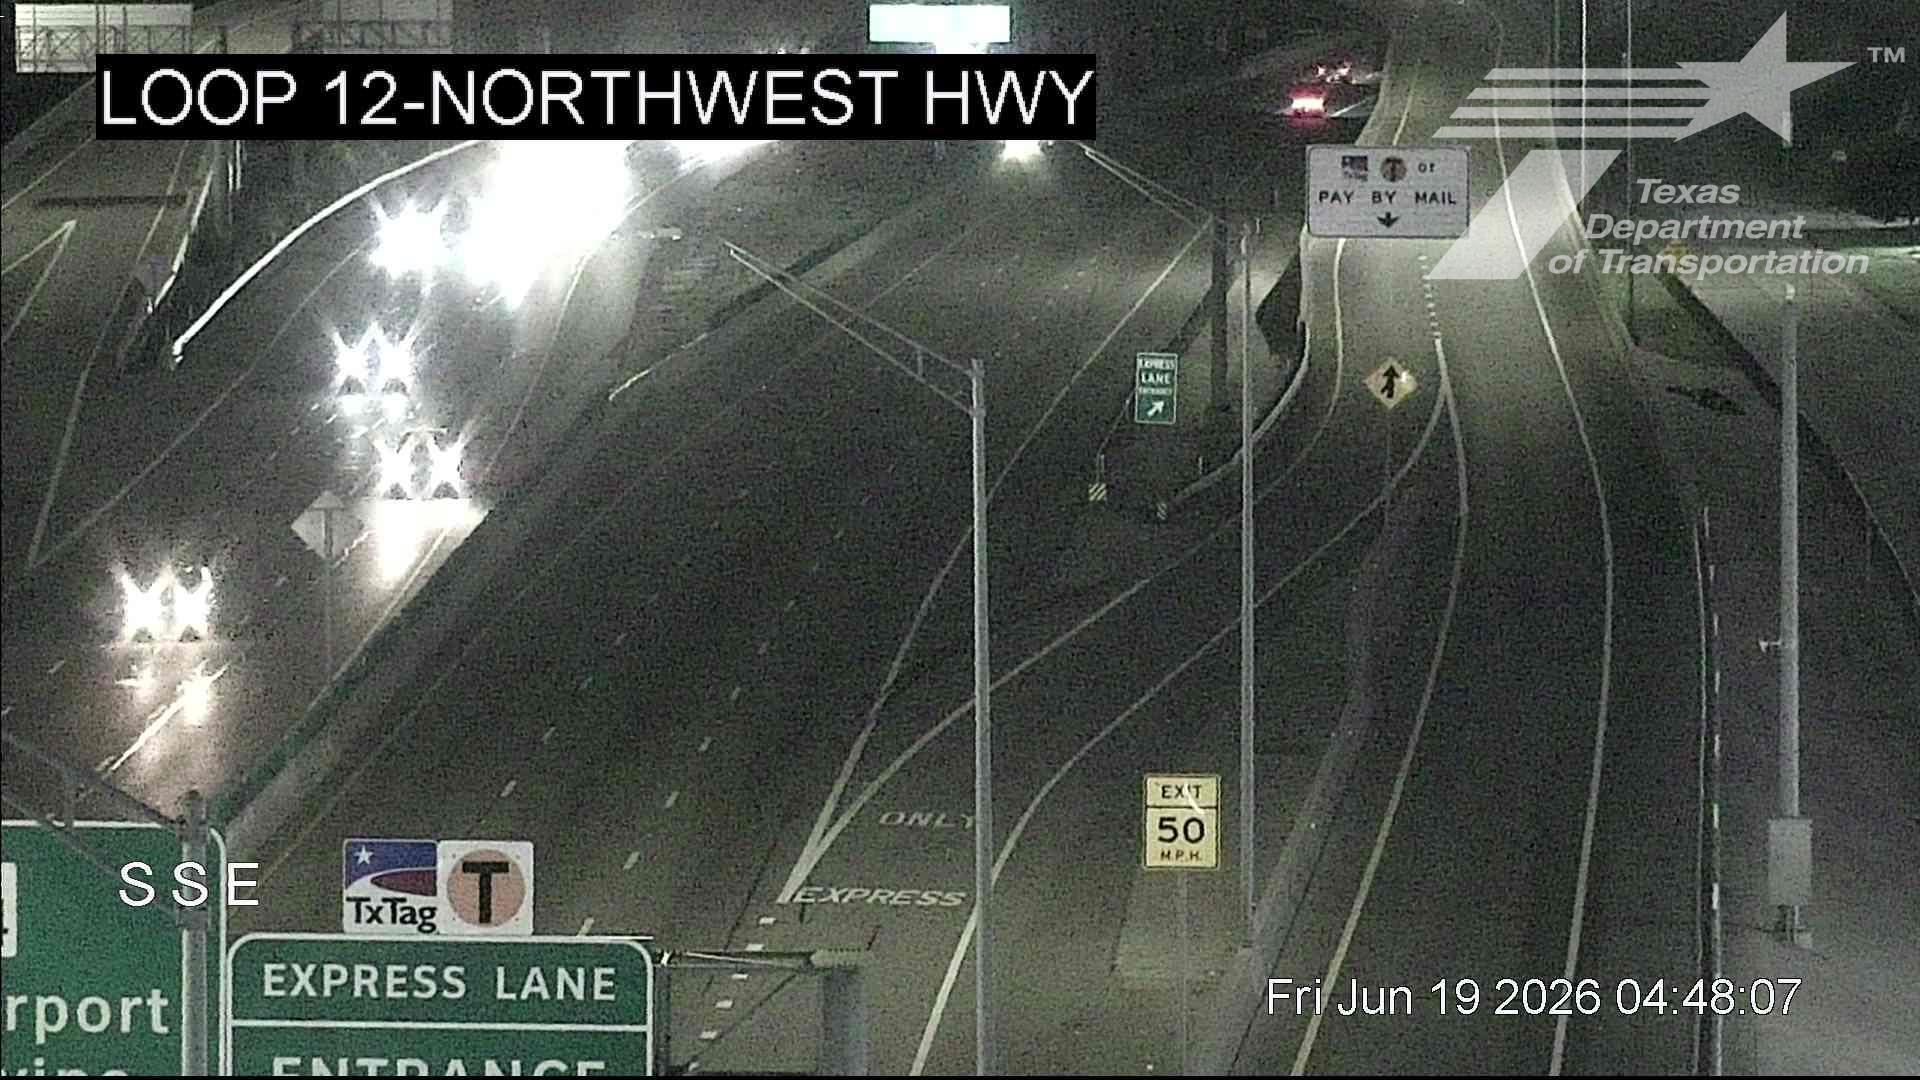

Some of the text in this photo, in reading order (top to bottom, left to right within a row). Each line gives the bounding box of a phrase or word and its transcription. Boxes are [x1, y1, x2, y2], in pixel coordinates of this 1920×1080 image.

[1319, 190, 1457, 205] PAY BY MAIL
[1161, 784, 1202, 799] EXIT
[879, 811, 976, 829] ONLY
[1158, 816, 1205, 844] 50
[462, 861, 510, 924] T
[793, 886, 966, 906] EXPRESS
[345, 896, 437, 934] TxTag
[263, 963, 616, 1001] EXPRESS LANE
[6, 989, 170, 1044] rport
